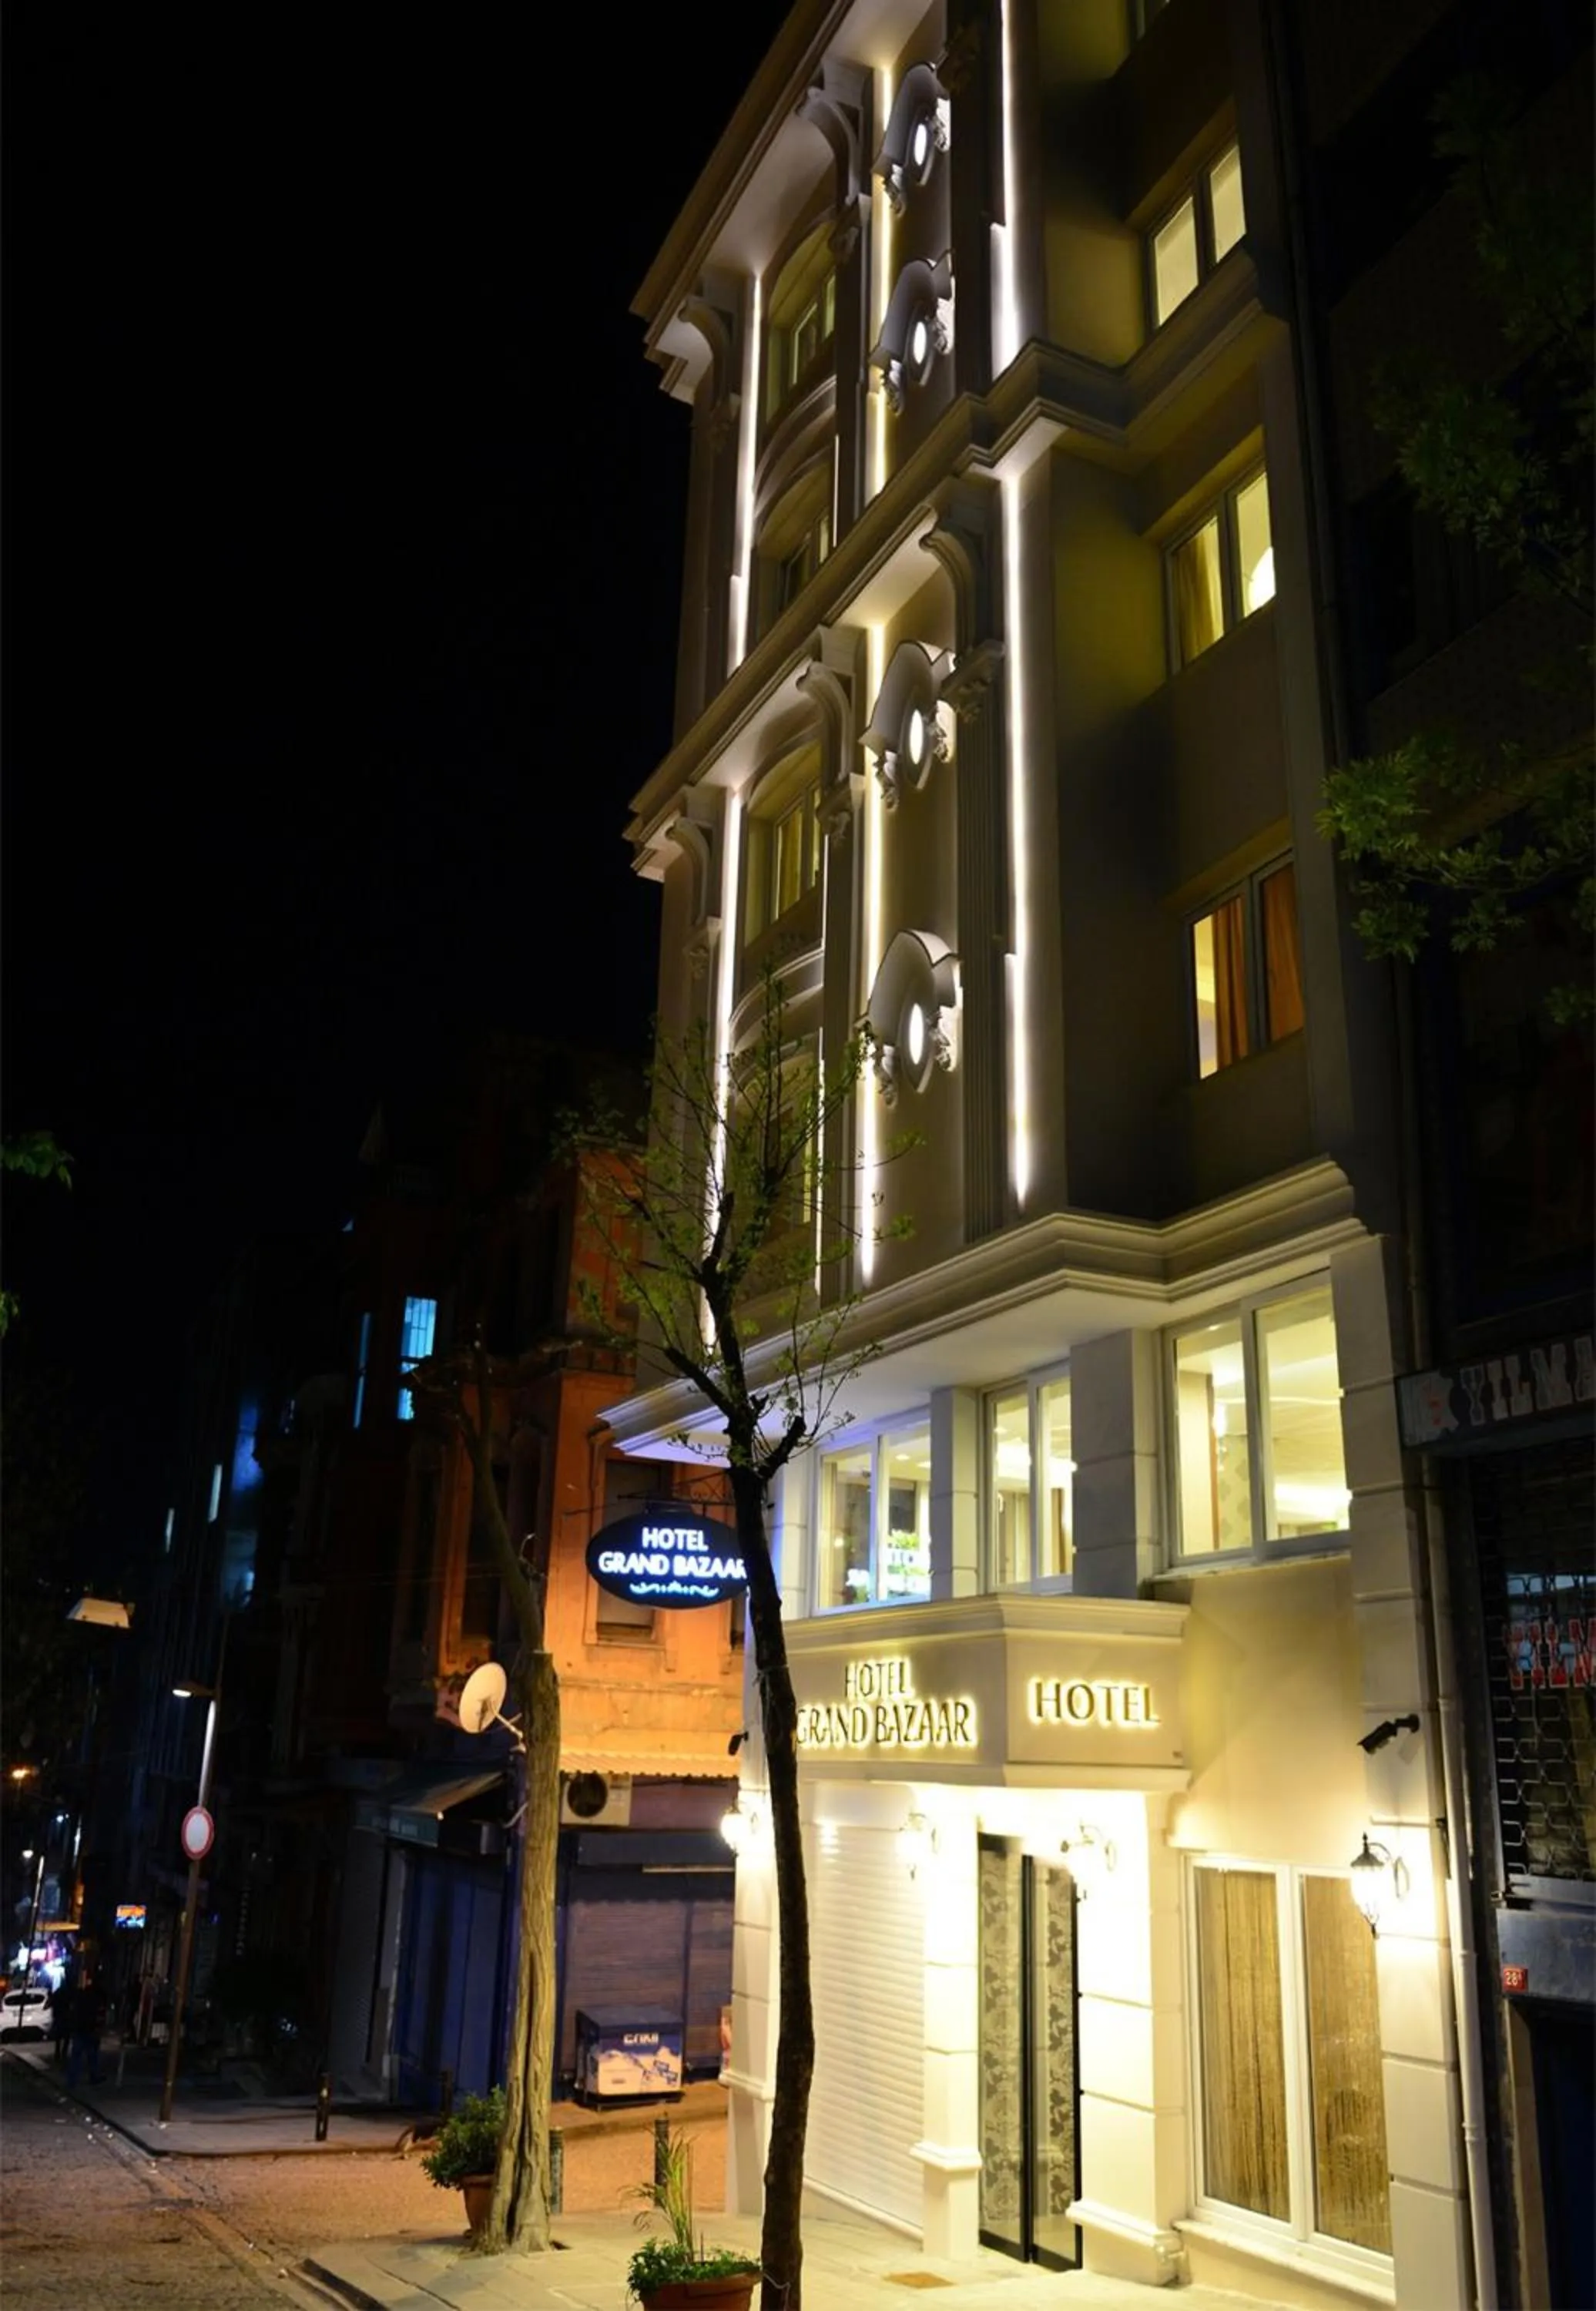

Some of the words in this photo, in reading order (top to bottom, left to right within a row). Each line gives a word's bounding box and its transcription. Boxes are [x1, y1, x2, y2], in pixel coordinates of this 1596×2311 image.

[642, 1527, 709, 1551] HOTEL
[598, 1551, 670, 1576] GRAND
[673, 1555, 747, 1579] BAZAAR
[844, 1659, 914, 1699] HOTEL
[796, 1706, 868, 1745] GRAND
[875, 1700, 974, 1744] BAZAAR
[1035, 1682, 1162, 1723] HOTEL
